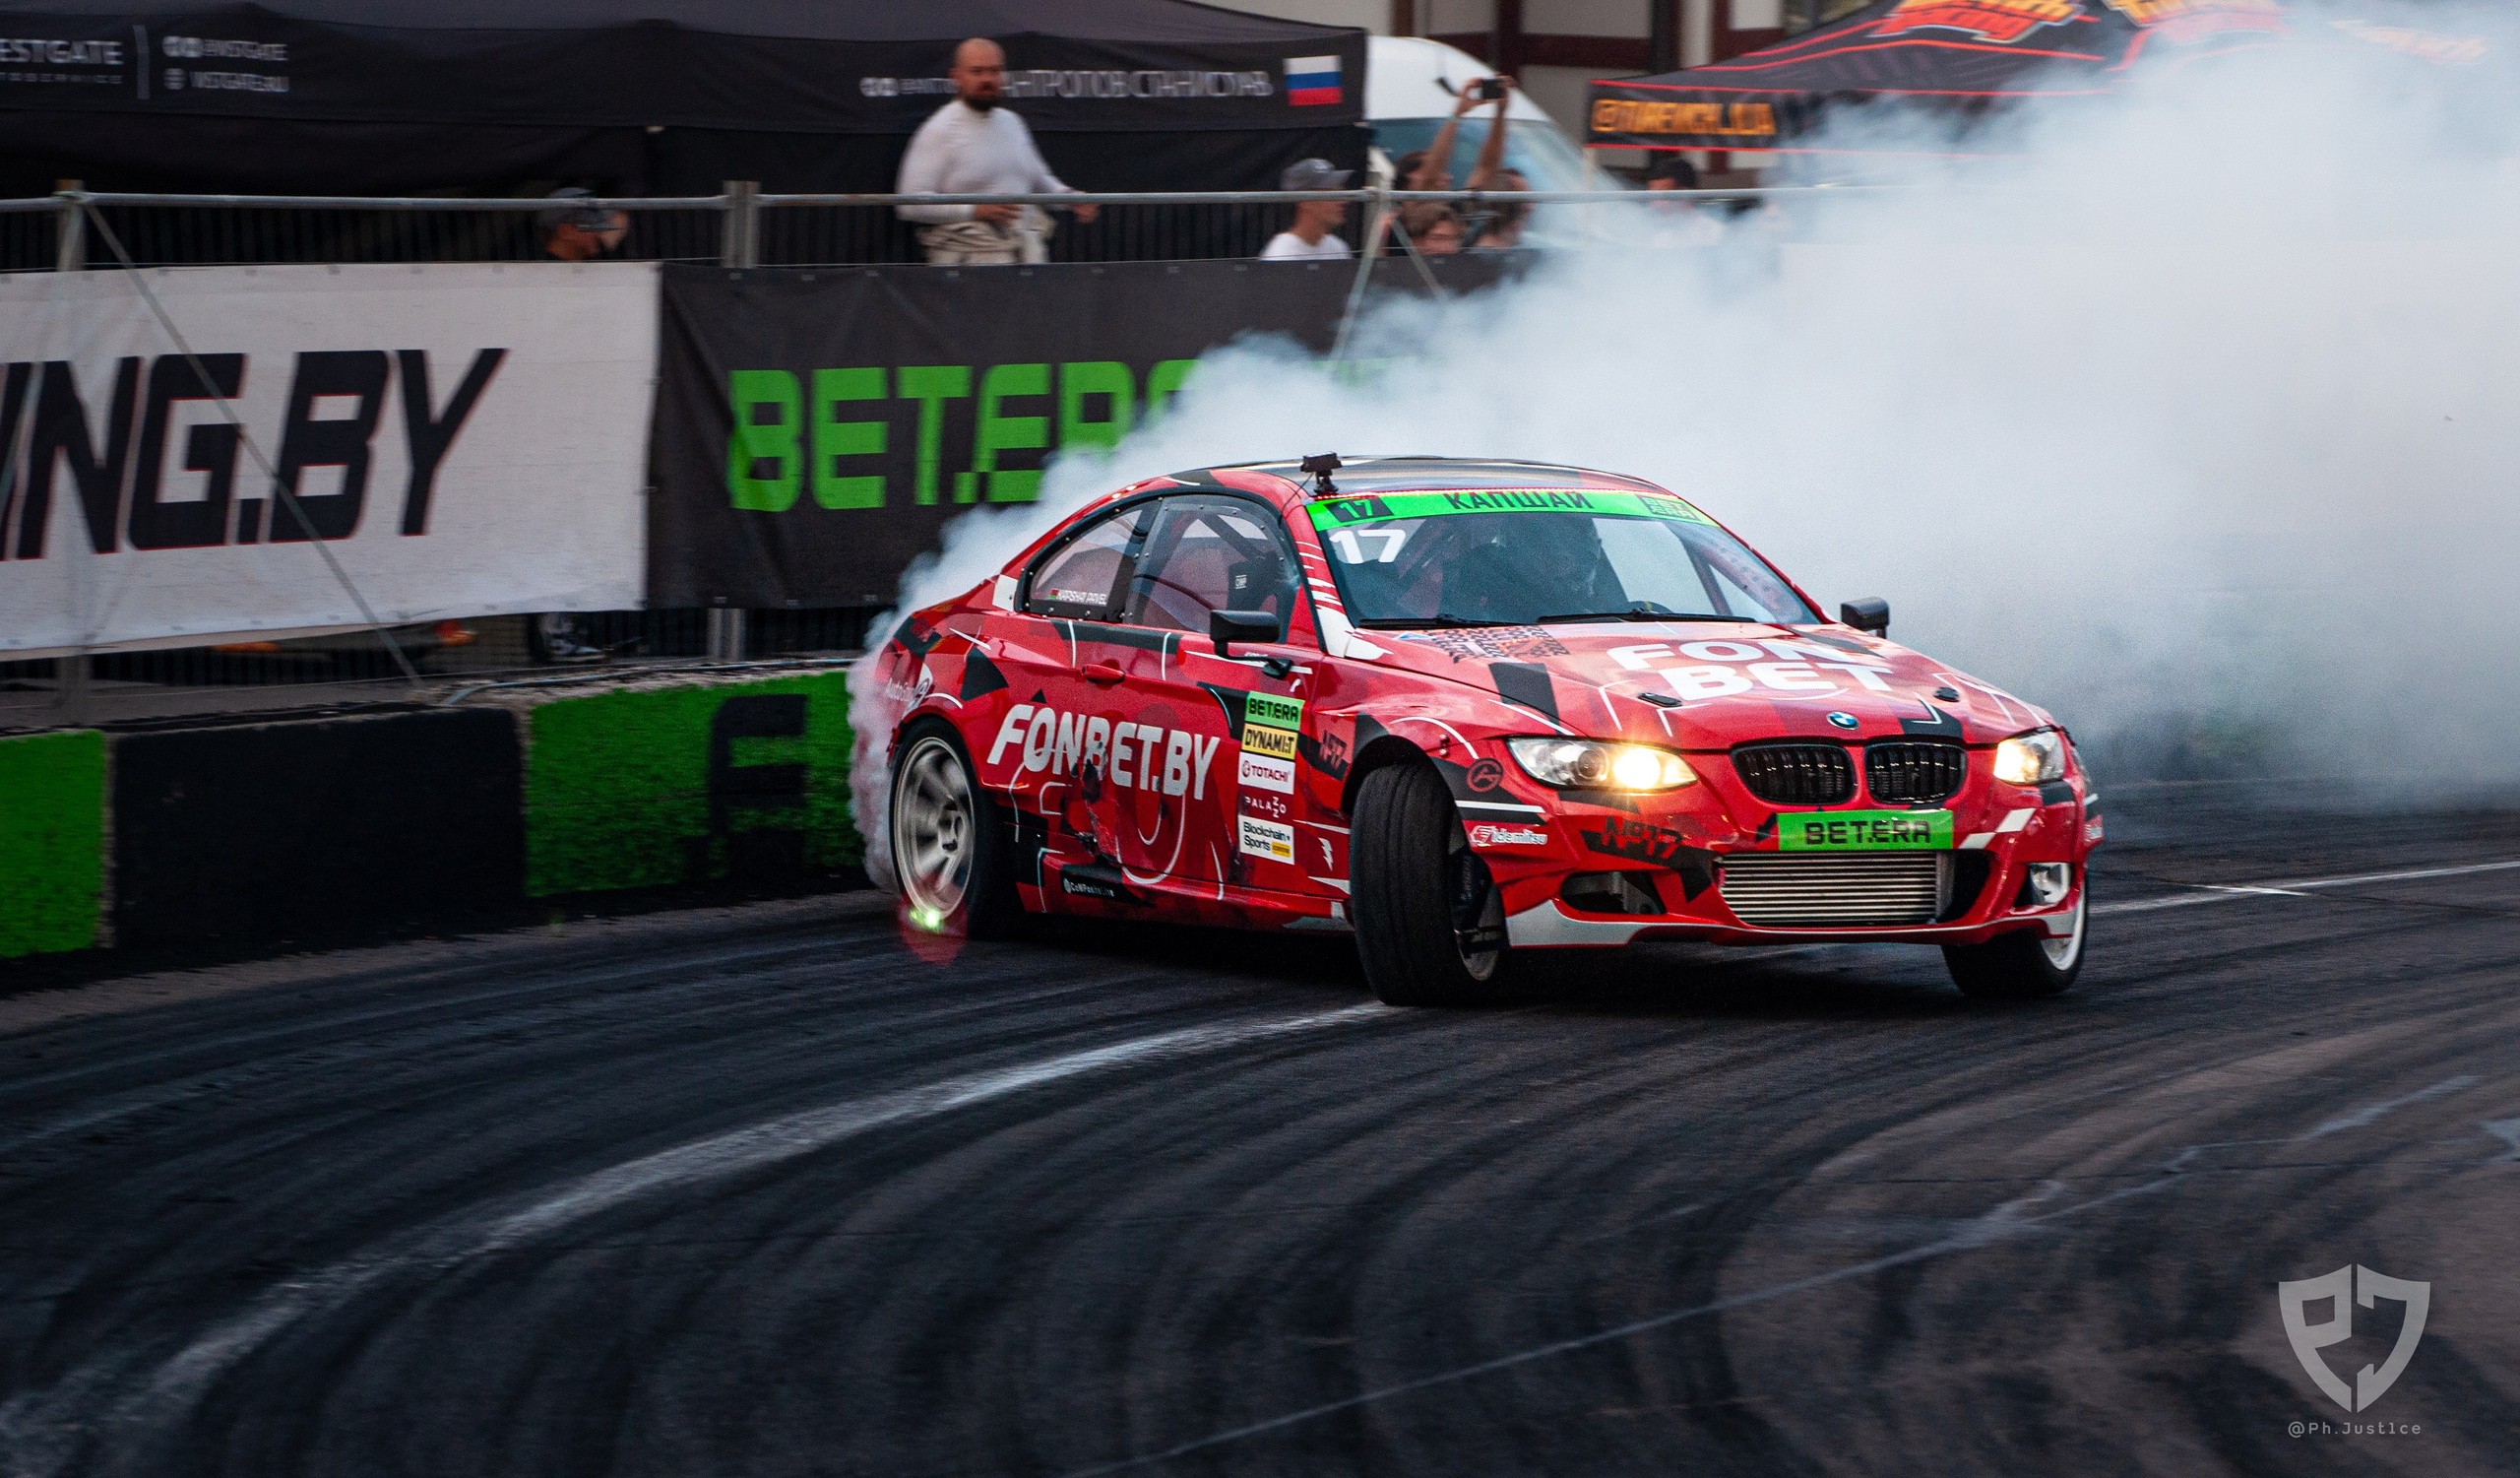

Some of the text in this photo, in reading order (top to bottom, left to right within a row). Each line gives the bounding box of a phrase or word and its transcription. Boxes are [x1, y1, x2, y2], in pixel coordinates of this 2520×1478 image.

[1339, 498, 1374, 519] 17
[1329, 529, 1407, 564] 17
[1606, 640, 1858, 671] FON
[1659, 662, 1894, 701] BET
[986, 703, 1221, 801] FONBET.BY
[1251, 765, 1289, 783] TOTACHI
[1243, 835, 1271, 852] Sports
[1803, 820, 1931, 846] BET.ERA
